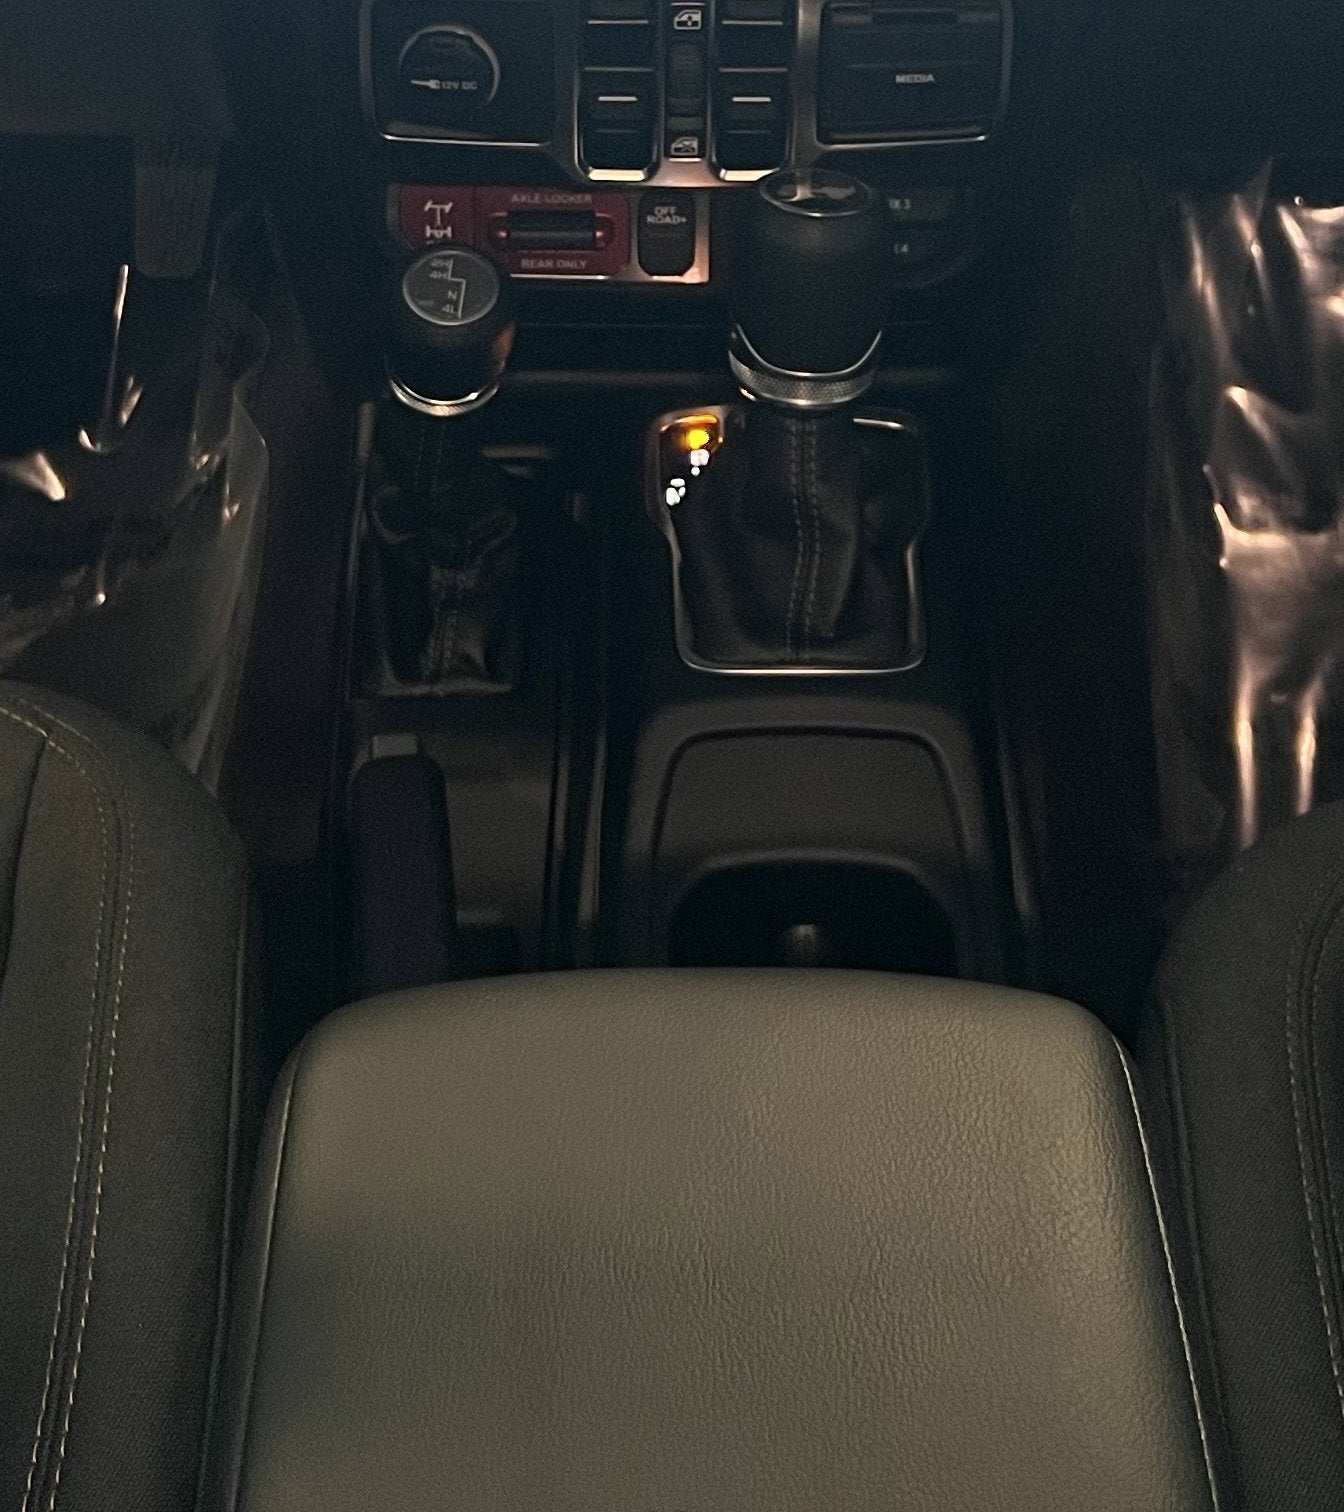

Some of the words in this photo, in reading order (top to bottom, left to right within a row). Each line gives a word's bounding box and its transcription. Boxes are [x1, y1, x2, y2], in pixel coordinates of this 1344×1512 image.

[895, 74, 935, 83] MEDIA
[441, 80, 460, 90] 12V
[462, 80, 478, 90] DC
[511, 194, 542, 204] AXLE
[545, 193, 592, 204] LOCKER
[654, 206, 678, 215] OFF
[521, 259, 553, 270] REAR
[556, 259, 588, 270] ONLY
[430, 270, 447, 279] 4H
[447, 290, 458, 301] N
[442, 304, 455, 315] 4L
